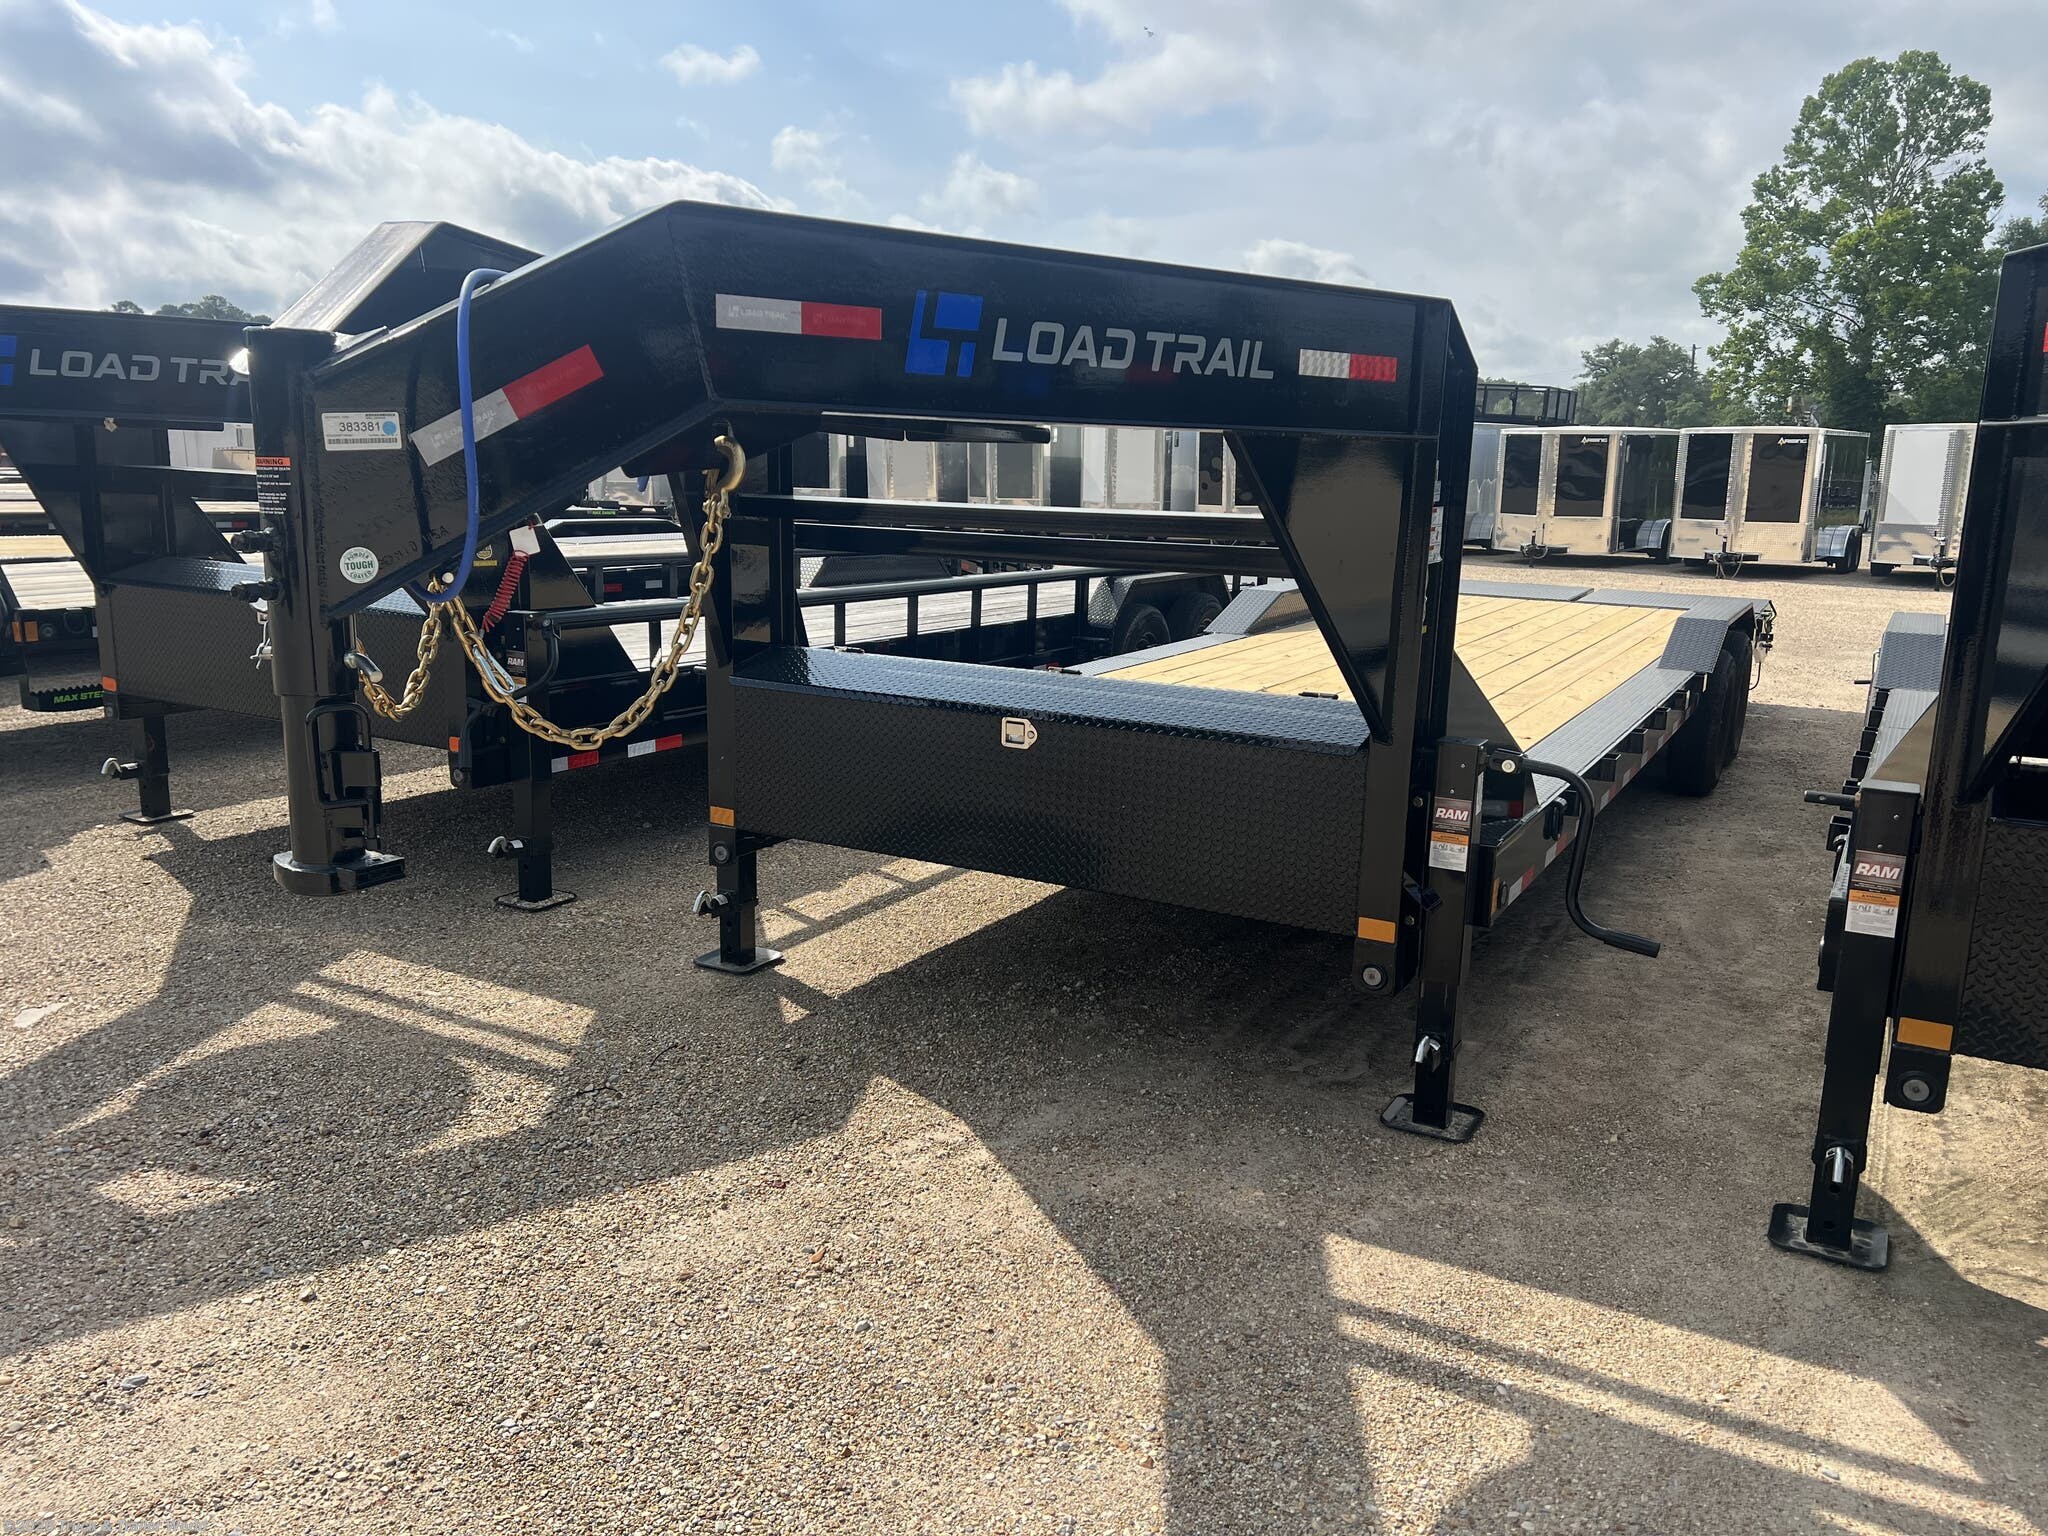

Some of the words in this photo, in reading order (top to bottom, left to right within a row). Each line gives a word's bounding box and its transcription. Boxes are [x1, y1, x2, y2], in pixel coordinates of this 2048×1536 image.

[992, 317, 1136, 370] LOAD
[1146, 331, 1275, 380] TRAIL
[29, 348, 161, 381] LOAD
[339, 421, 380, 432] 383381
[344, 560, 374, 571] TOUGH
[507, 657, 525, 667] RAM
[54, 694, 78, 704] MAX
[1435, 807, 1468, 821] RAM
[1855, 862, 1900, 880] RAM
